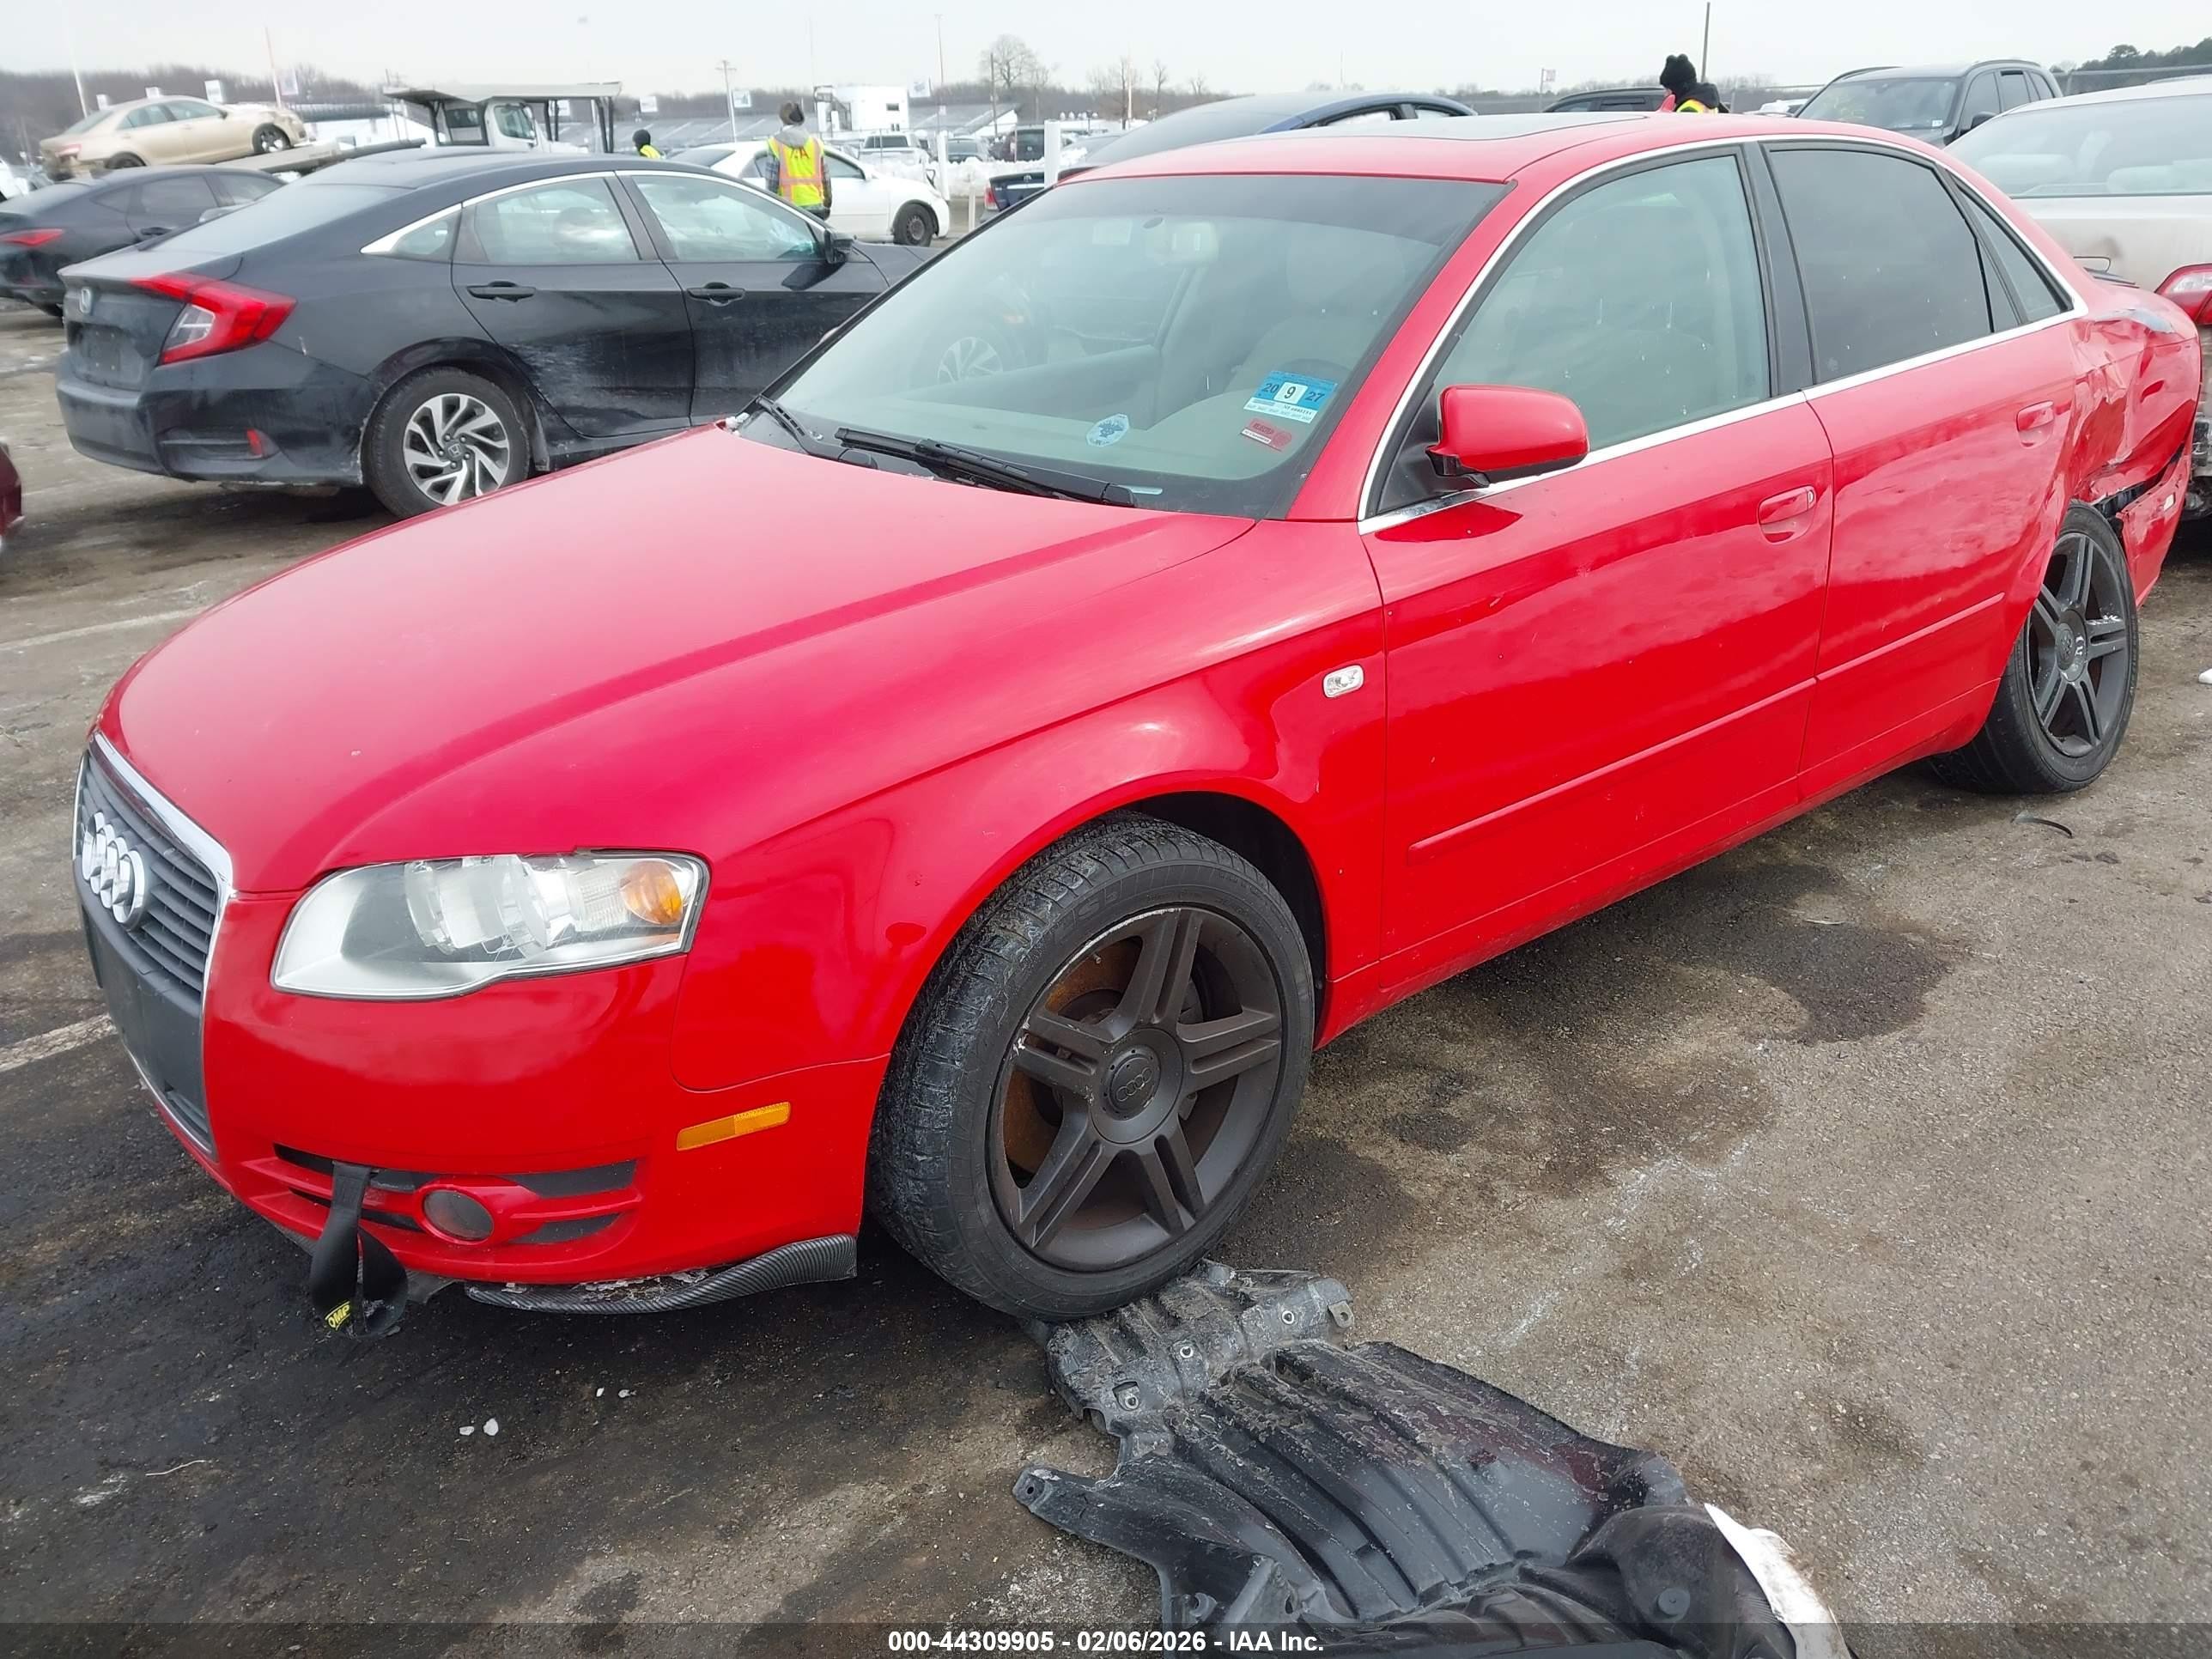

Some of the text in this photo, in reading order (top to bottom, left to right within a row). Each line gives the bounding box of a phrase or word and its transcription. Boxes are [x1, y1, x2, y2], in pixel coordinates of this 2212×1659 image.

[1261, 383, 1326, 403] 20 9 27
[328, 1304, 350, 1328] OMP
